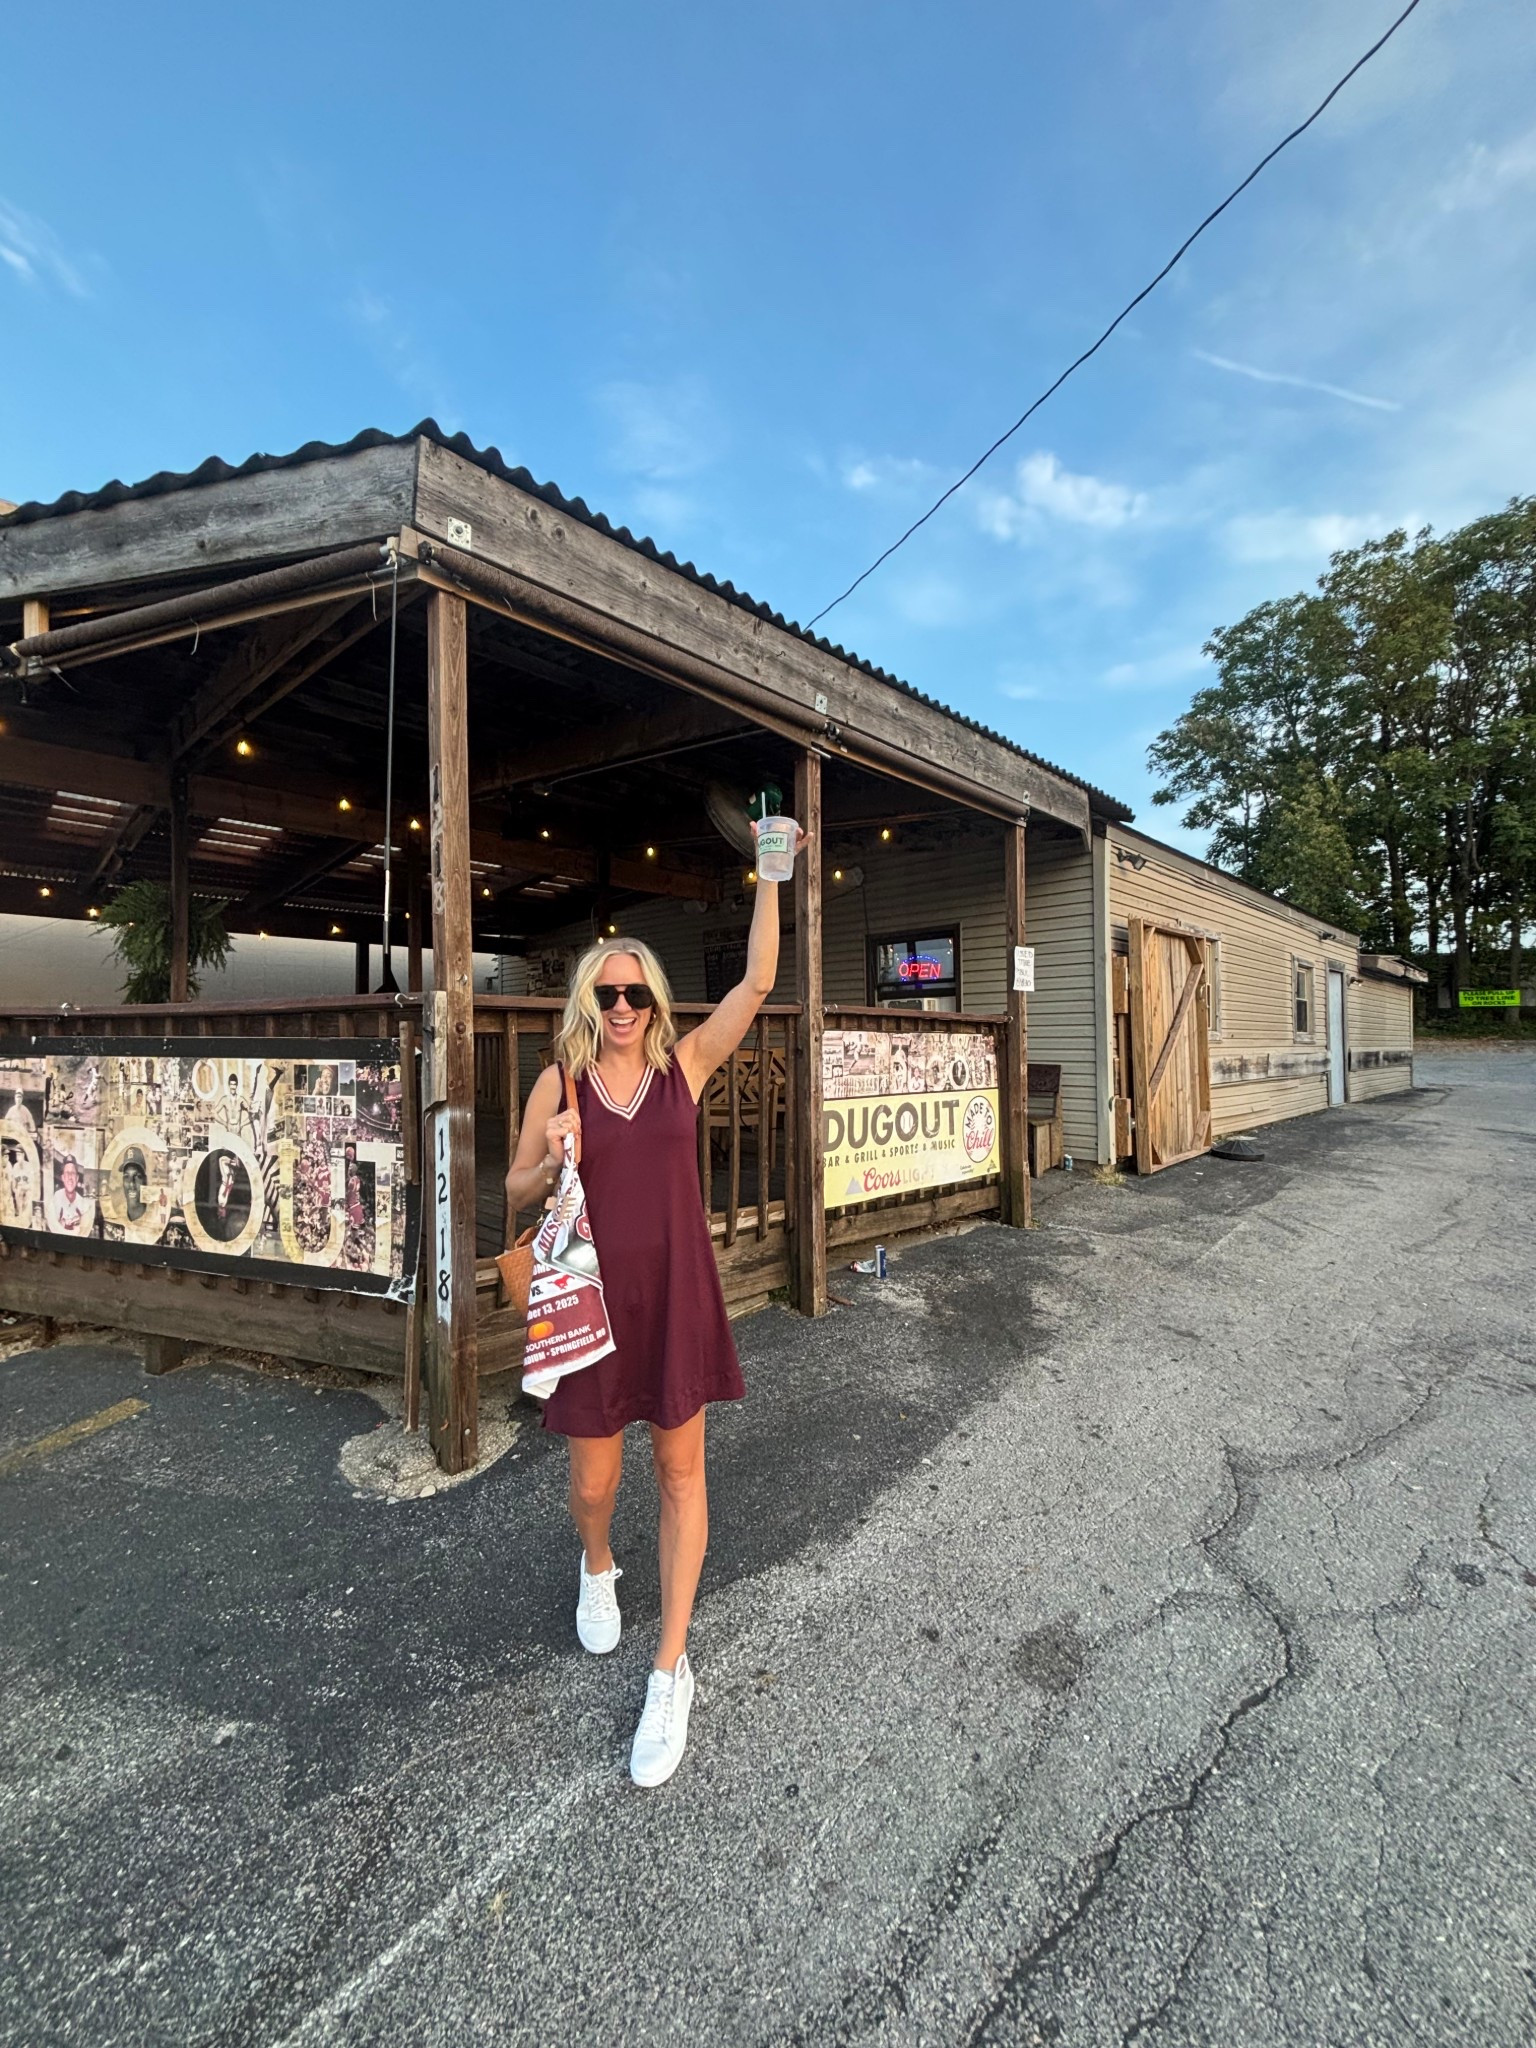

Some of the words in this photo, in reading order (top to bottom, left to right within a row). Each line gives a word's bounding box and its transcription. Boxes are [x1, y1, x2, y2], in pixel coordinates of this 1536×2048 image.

[898, 962, 941, 978] OPEN
[823, 1099, 960, 1153] DUGOUT
[965, 1102, 984, 1129] MADE
[984, 1107, 993, 1126] TO
[966, 1128, 994, 1151] Chill
[823, 1155, 840, 1169] BAR
[854, 1149, 878, 1164] GRILL
[889, 1143, 919, 1158] SPORTS
[930, 1138, 956, 1151] MUSIC
[863, 1166, 902, 1193] Coors
[437, 1127, 451, 1301] 1218
[530, 1285, 544, 1297] VS.
[542, 1302, 556, 1315] 13,
[555, 1294, 580, 1311] 2025
[525, 1332, 567, 1353] SOUTHERN
[567, 1324, 592, 1339] BANK
[596, 1327, 607, 1340] MO
